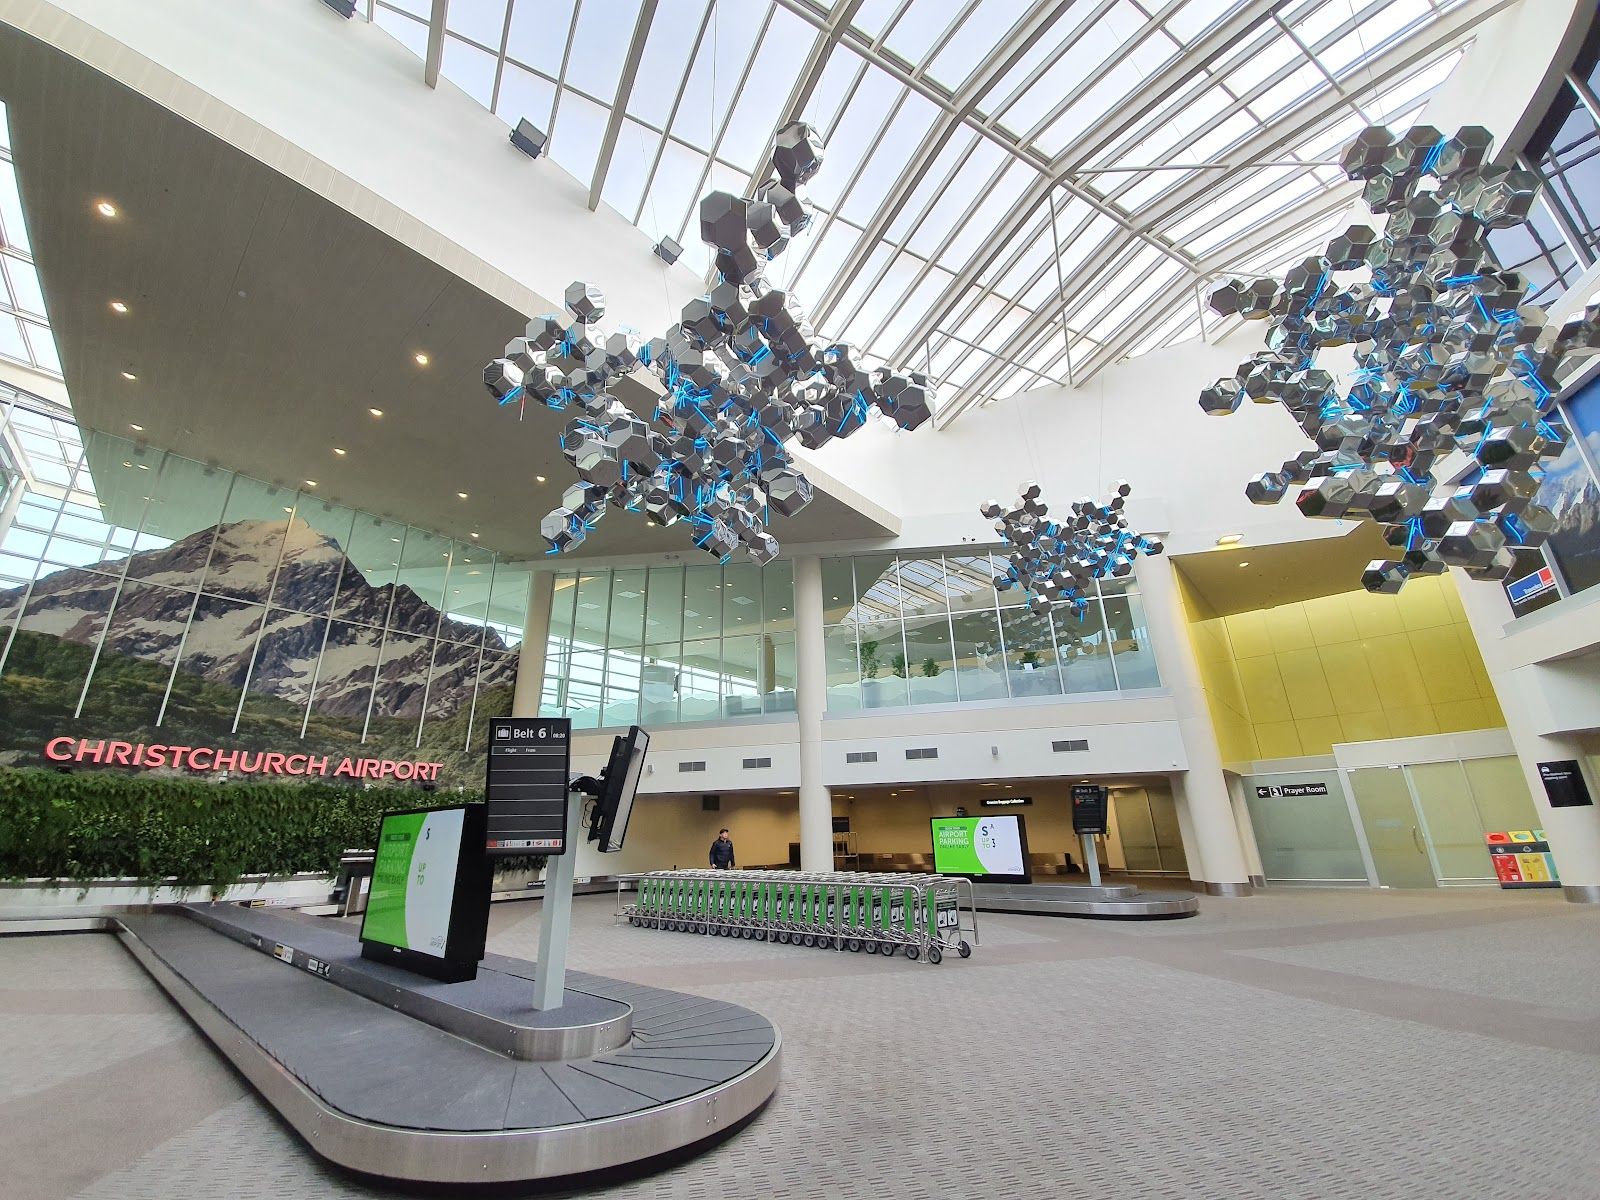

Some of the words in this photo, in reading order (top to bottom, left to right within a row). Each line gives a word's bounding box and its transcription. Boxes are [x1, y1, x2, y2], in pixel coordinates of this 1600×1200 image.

[513, 728, 534, 739] Belt
[538, 728, 547, 739] 6
[46, 736, 328, 776] CHRISTCHURCH
[333, 757, 443, 781] AIRPORT
[1284, 787, 1305, 795] Prayer
[938, 830, 968, 838] AIRPORT
[939, 837, 969, 845] PARKING
